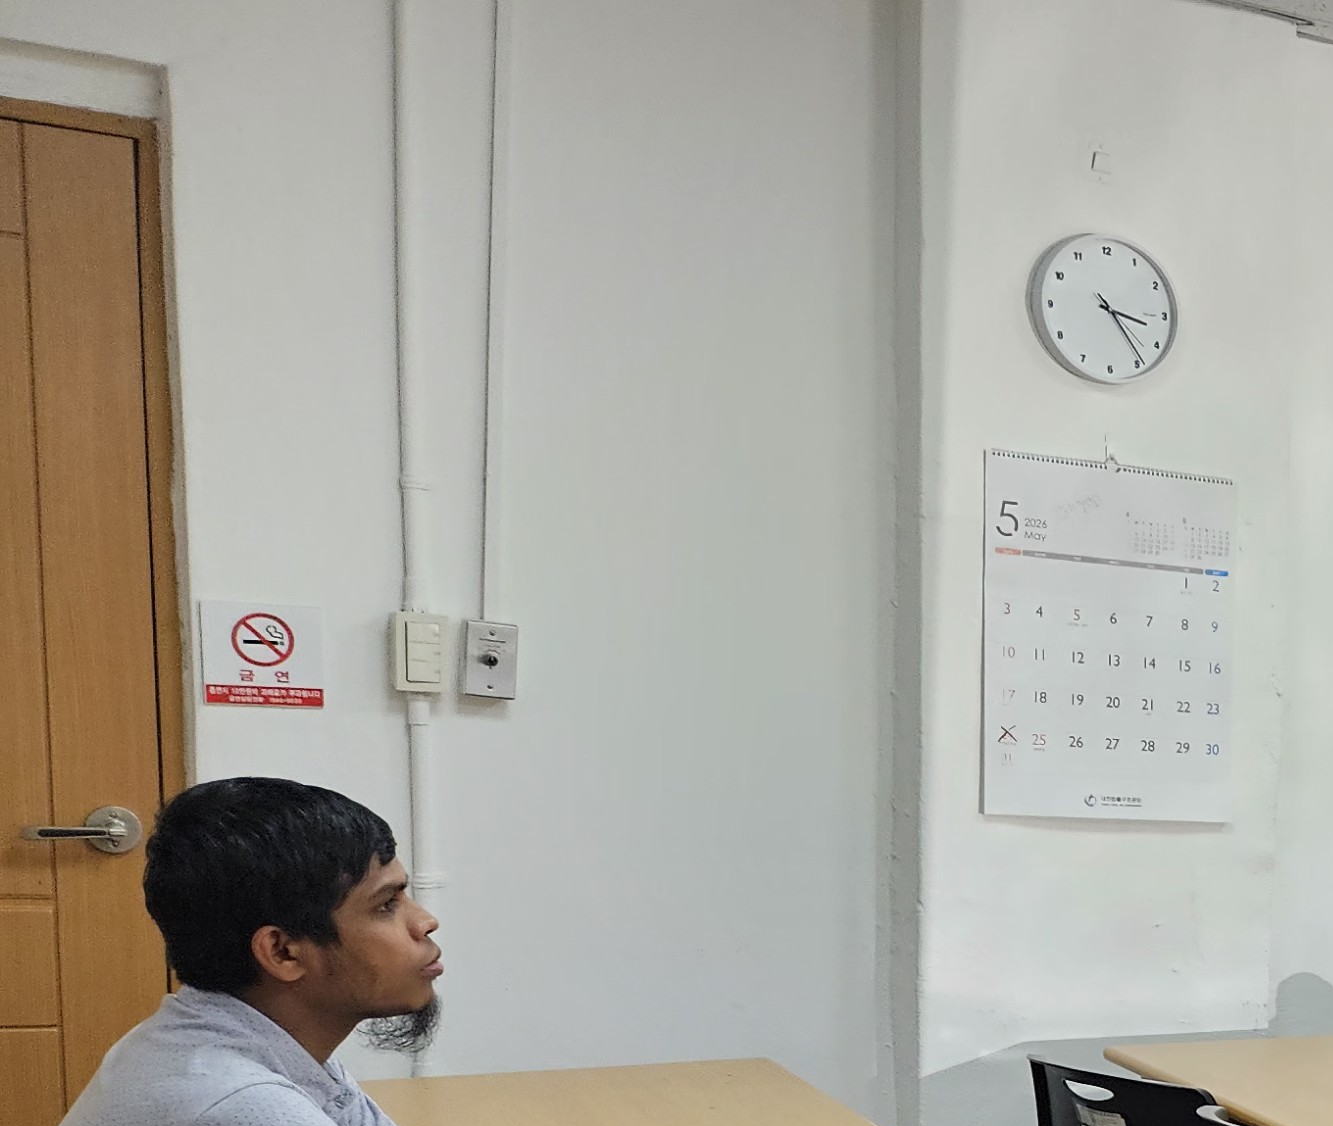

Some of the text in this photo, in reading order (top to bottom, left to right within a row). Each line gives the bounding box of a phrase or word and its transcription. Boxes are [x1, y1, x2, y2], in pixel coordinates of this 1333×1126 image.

[1102, 247, 1111, 255] 12
[1074, 252, 1082, 260] 11
[1133, 258, 1136, 266] 1
[1056, 272, 1064, 280] 10
[1153, 281, 1158, 290] 2
[1048, 300, 1053, 308] 9
[1162, 312, 1167, 321] 3
[1057, 331, 1063, 339] 8
[1080, 354, 1086, 362] 7
[1135, 359, 1141, 368] 5
[996, 501, 1018, 536] 5
[1025, 518, 1048, 529] 2026
[1024, 531, 1047, 543] May
[1185, 578, 1219, 592] 1 2
[1004, 603, 1218, 632] 3 4 5 6 7 8 9
[1003, 646, 1221, 674] 10 11 12 13 14 15 16
[240, 669, 290, 683] 금 연
[1035, 692, 1046, 703] 18
[1072, 694, 1084, 705] 19
[1106, 697, 1120, 708] 20
[1142, 699, 1153, 710] 21
[1177, 701, 1190, 713] 22
[1207, 703, 1219, 715] 23
[1032, 734, 1219, 755] 25 26 27 28 29 30
